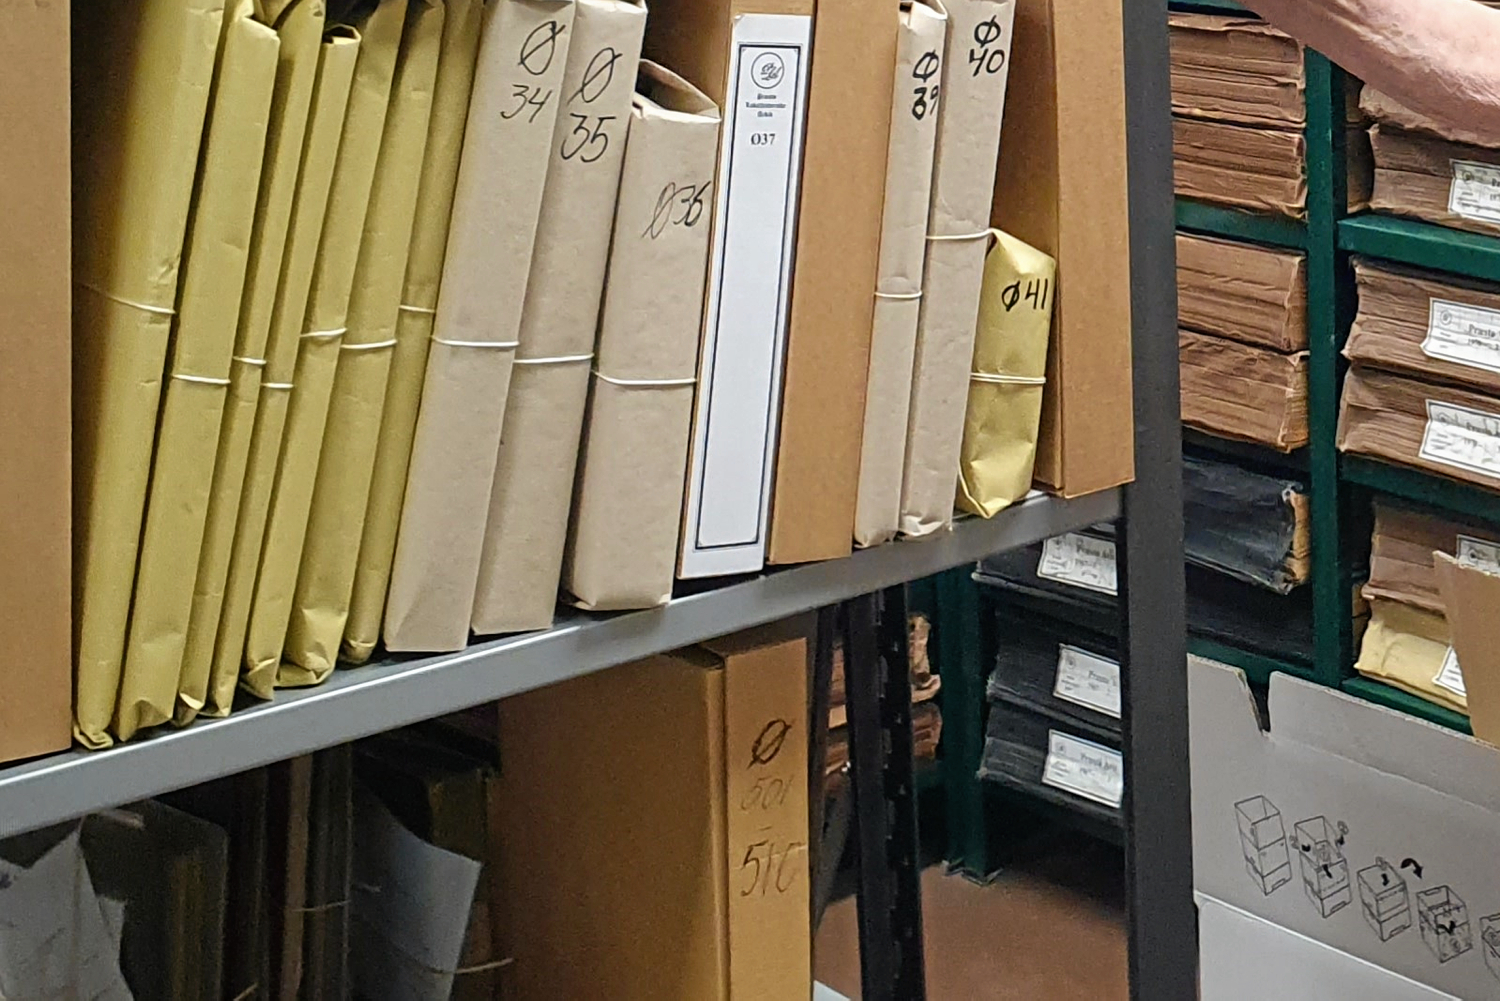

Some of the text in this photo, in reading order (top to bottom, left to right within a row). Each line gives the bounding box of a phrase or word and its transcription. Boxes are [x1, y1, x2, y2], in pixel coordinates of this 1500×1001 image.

[968, 48, 1005, 77] 40
[500, 84, 552, 123] 34
[561, 113, 616, 163] 35
